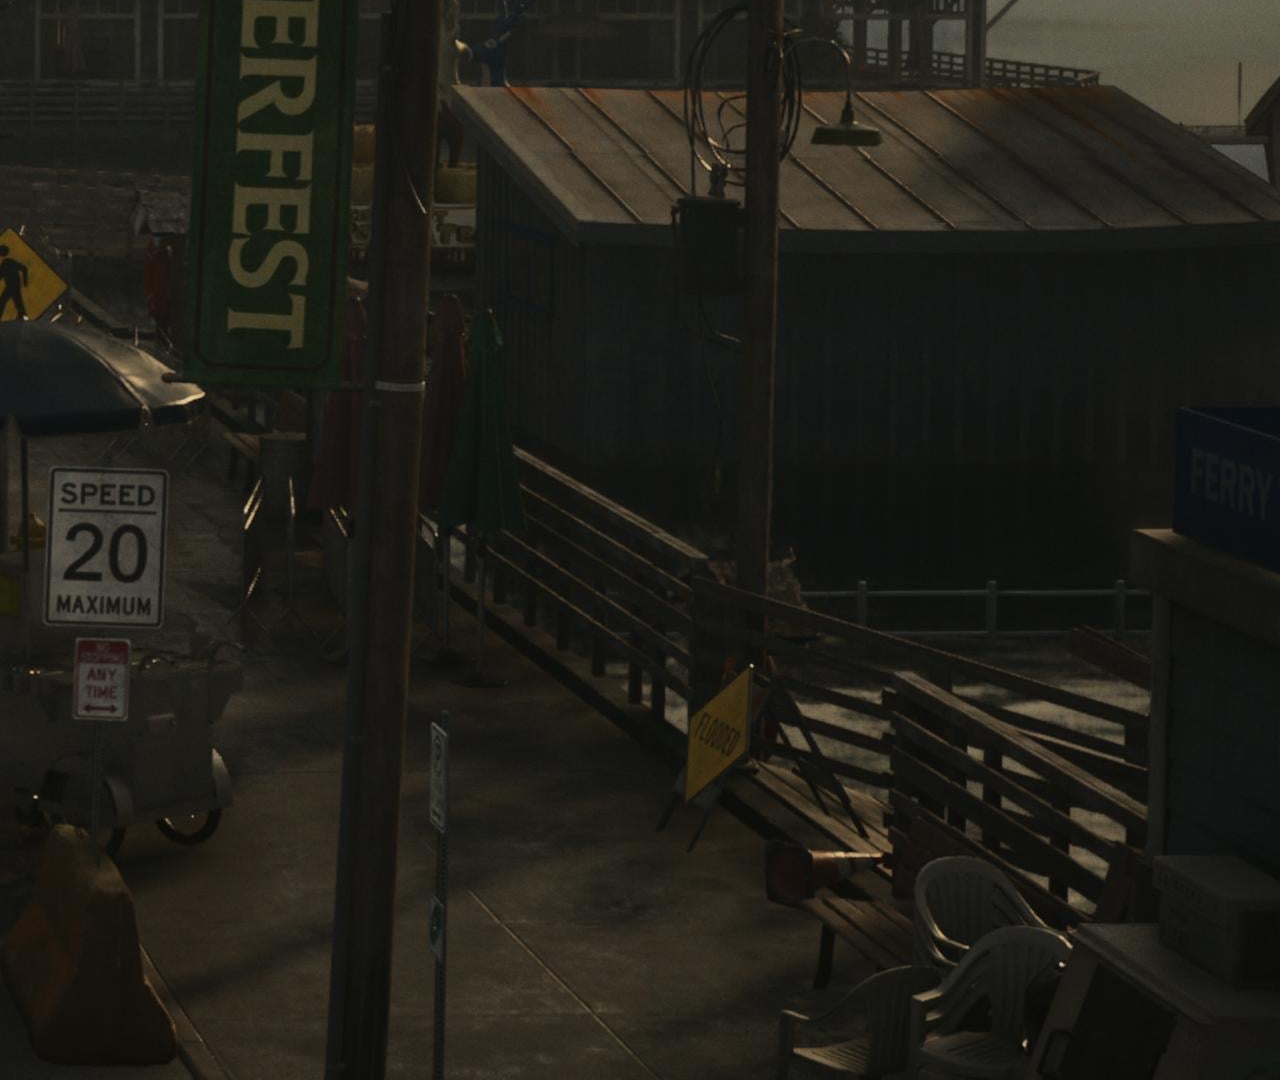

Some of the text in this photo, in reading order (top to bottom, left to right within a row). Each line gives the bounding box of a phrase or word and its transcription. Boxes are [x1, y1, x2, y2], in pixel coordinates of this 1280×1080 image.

[60, 482, 156, 506] SPEED
[1191, 447, 1273, 521] FERRY
[63, 522, 148, 584] 20
[56, 594, 152, 616] MAXIMUM
[87, 668, 118, 680] ANY
[85, 684, 118, 700] TIME
[694, 712, 741, 757] FLOODED
